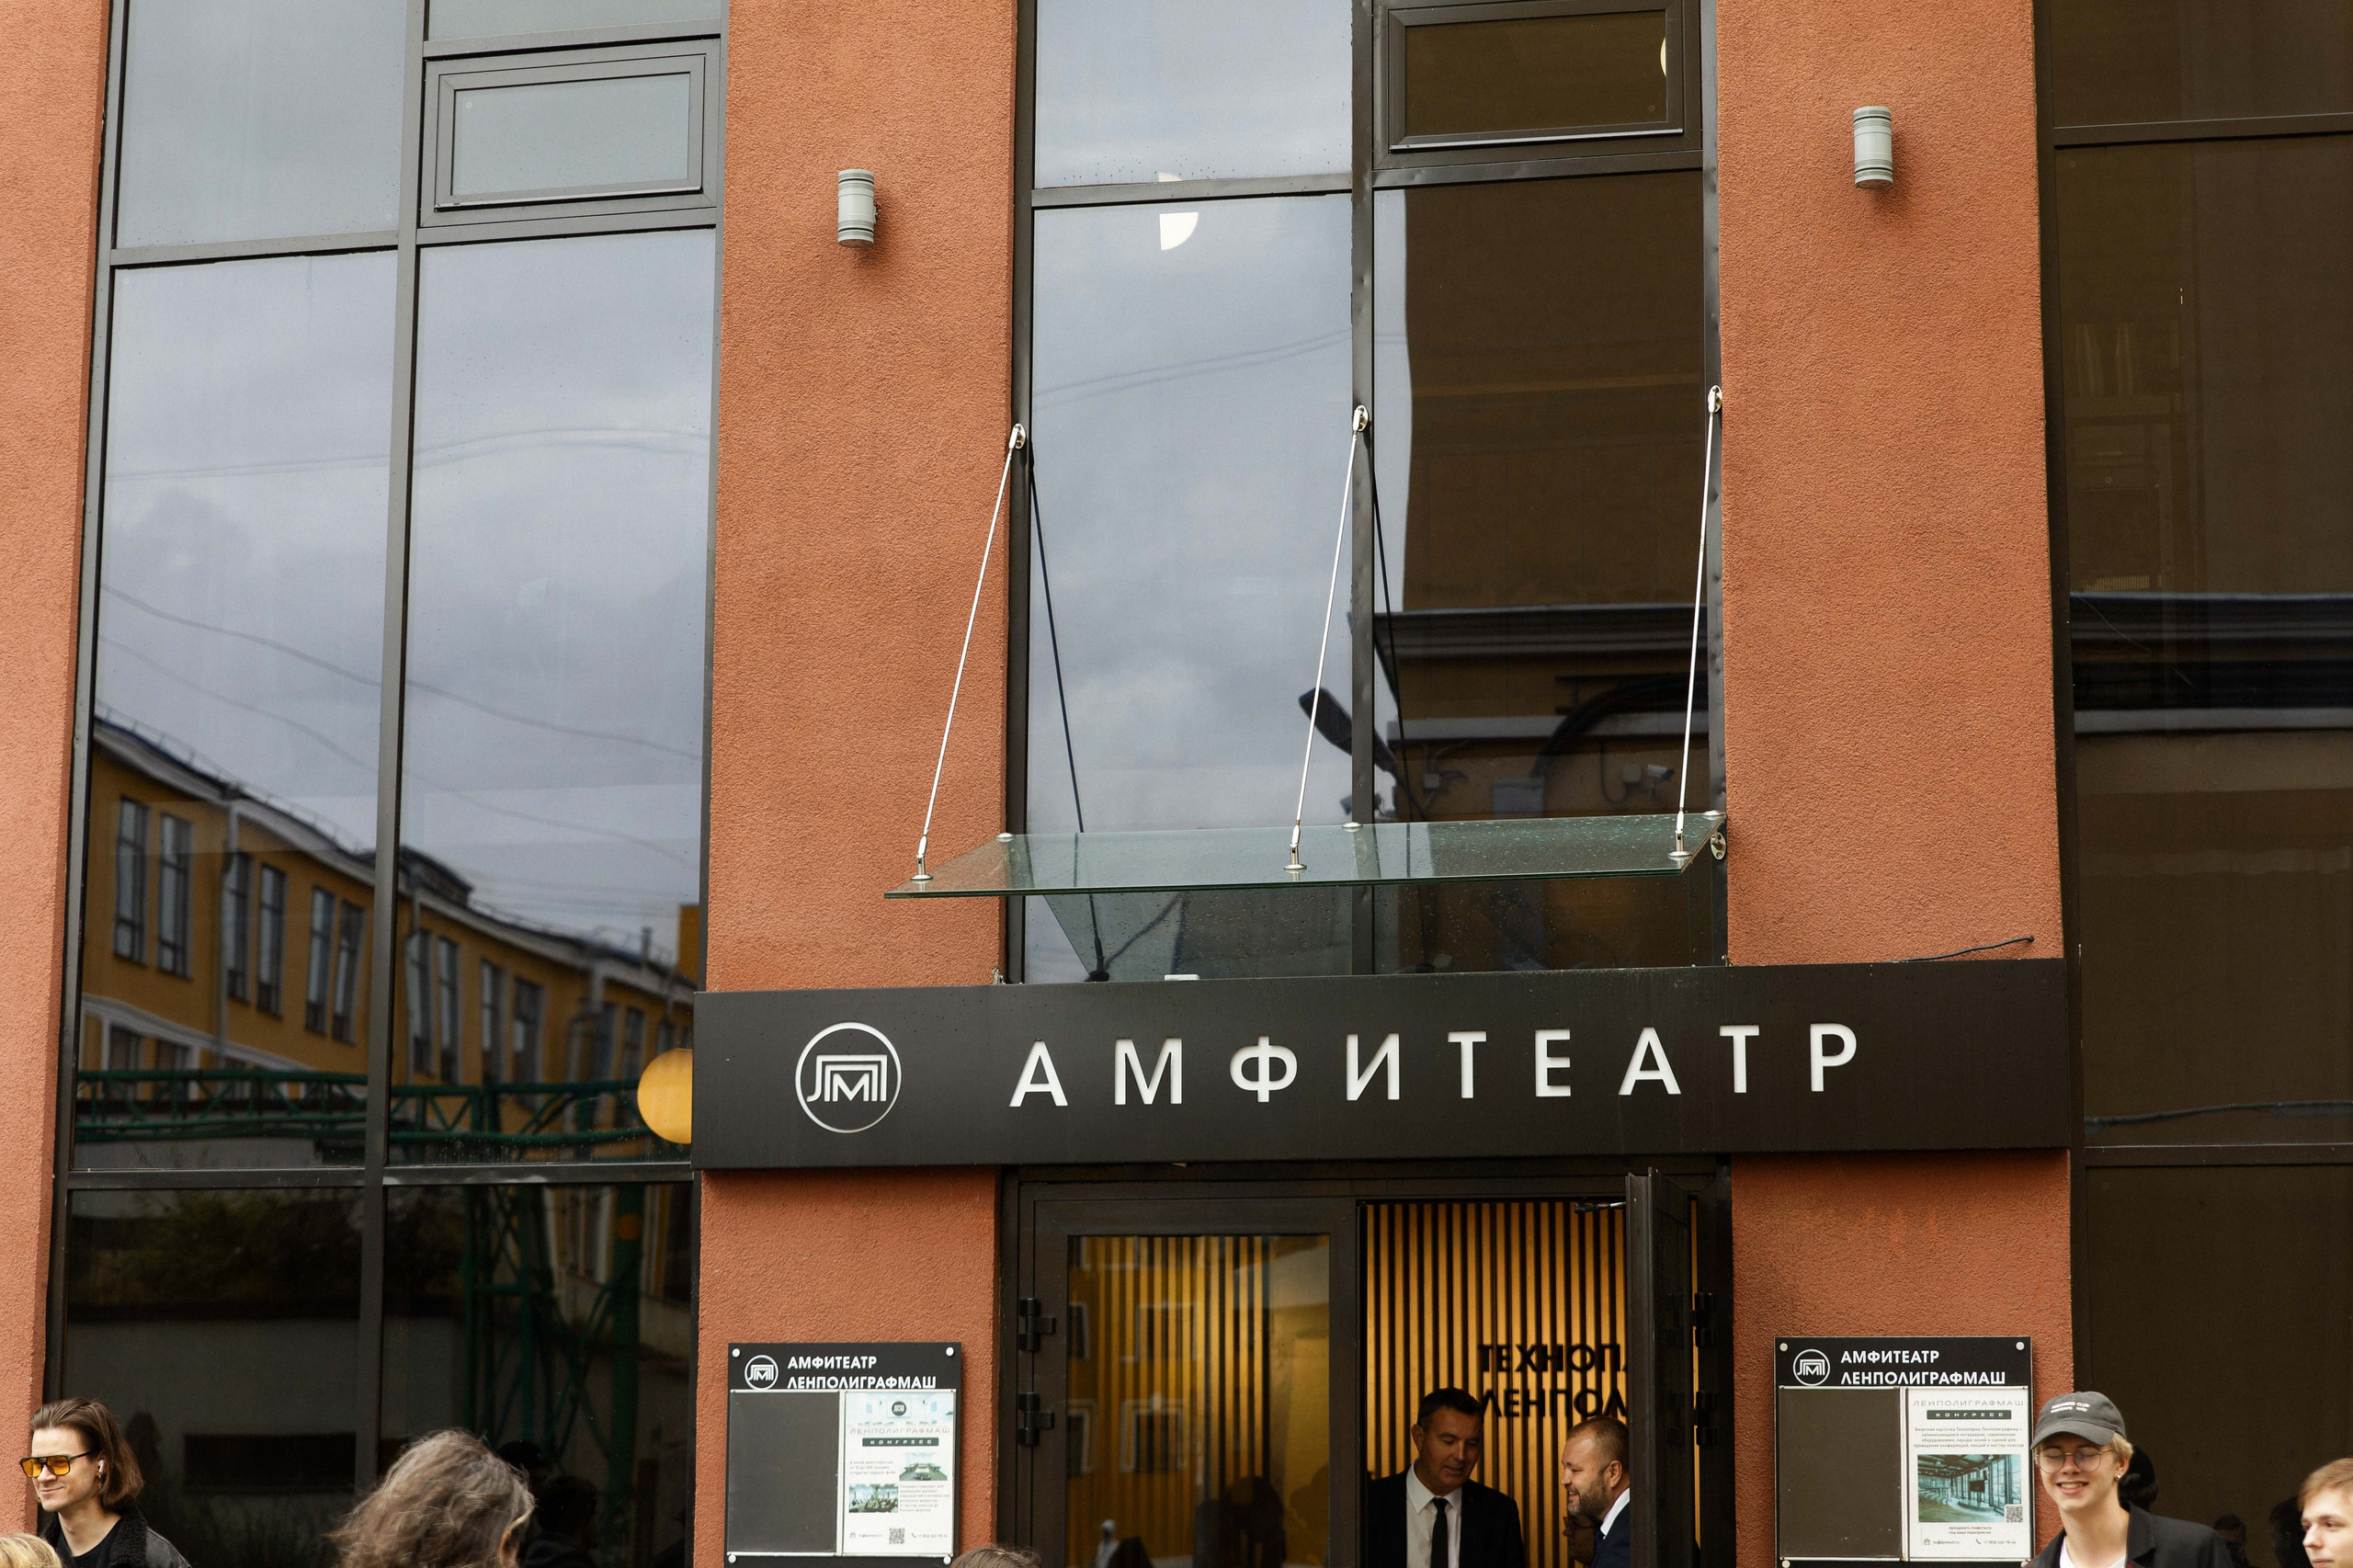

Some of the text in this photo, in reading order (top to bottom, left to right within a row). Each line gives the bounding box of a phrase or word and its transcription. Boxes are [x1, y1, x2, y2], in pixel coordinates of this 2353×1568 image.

[1009, 1022, 1859, 1108] АМФИТЕАТР
[787, 1356, 877, 1369] АМФИТЕАТР
[1478, 1344, 1628, 1372] ТЕХНОП
[1840, 1350, 1939, 1364] АМФИТЕАТР
[787, 1376, 937, 1390] ЛЕНПОЛИГРАФМАШ
[1840, 1371, 2006, 1385] ЛЕНПОЛИГРАФМАШ
